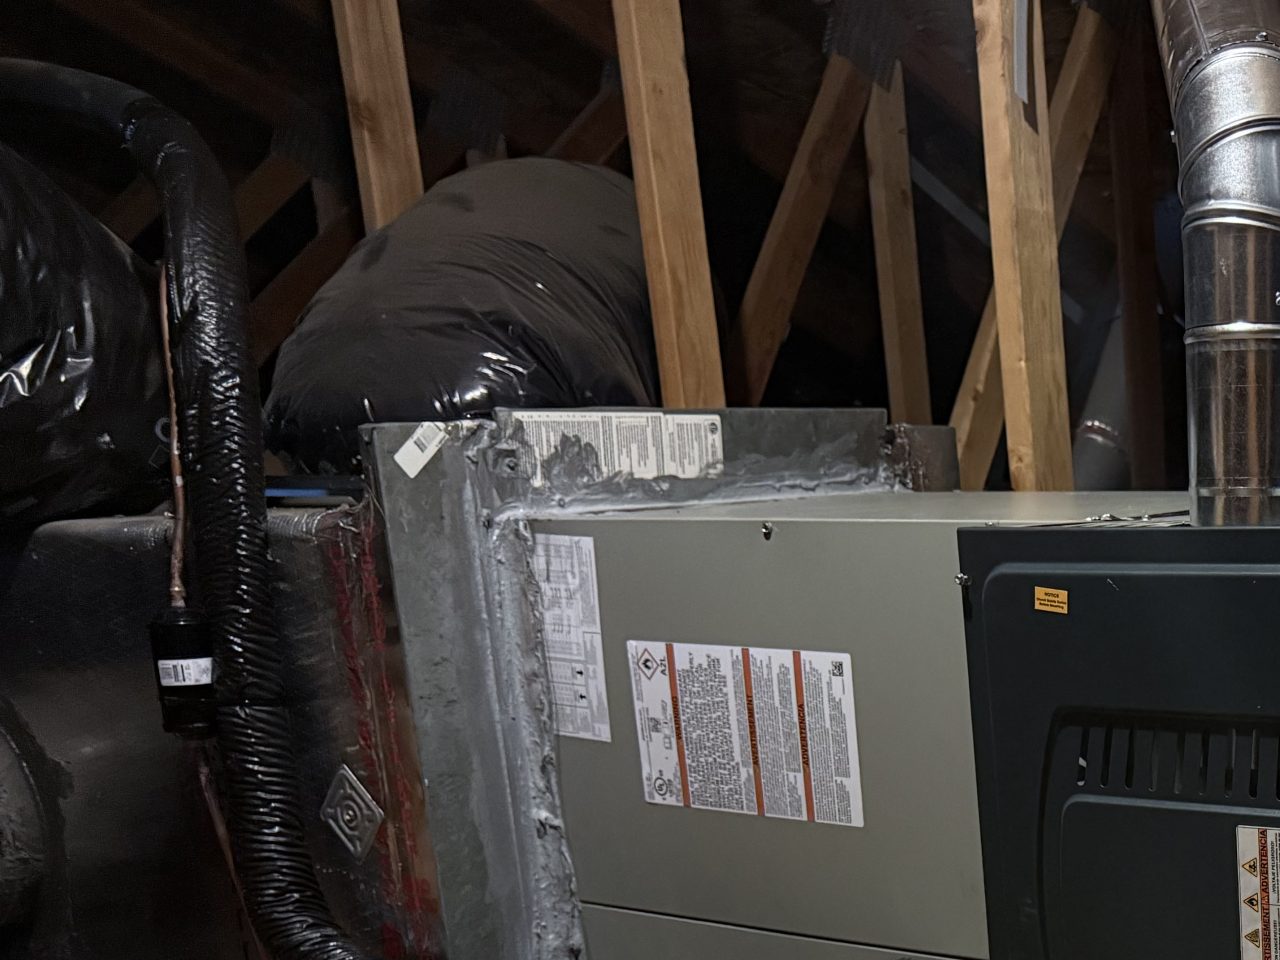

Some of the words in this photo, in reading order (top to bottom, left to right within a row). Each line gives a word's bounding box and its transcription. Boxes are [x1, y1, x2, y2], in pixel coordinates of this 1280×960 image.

[658, 655, 667, 675] A2L
[671, 695, 682, 740] WARNING
[745, 694, 759, 765] AVERTISSEMENT
[797, 703, 809, 765] ADVERTENCIA
[1259, 829, 1268, 893] ADVERTENCIA
